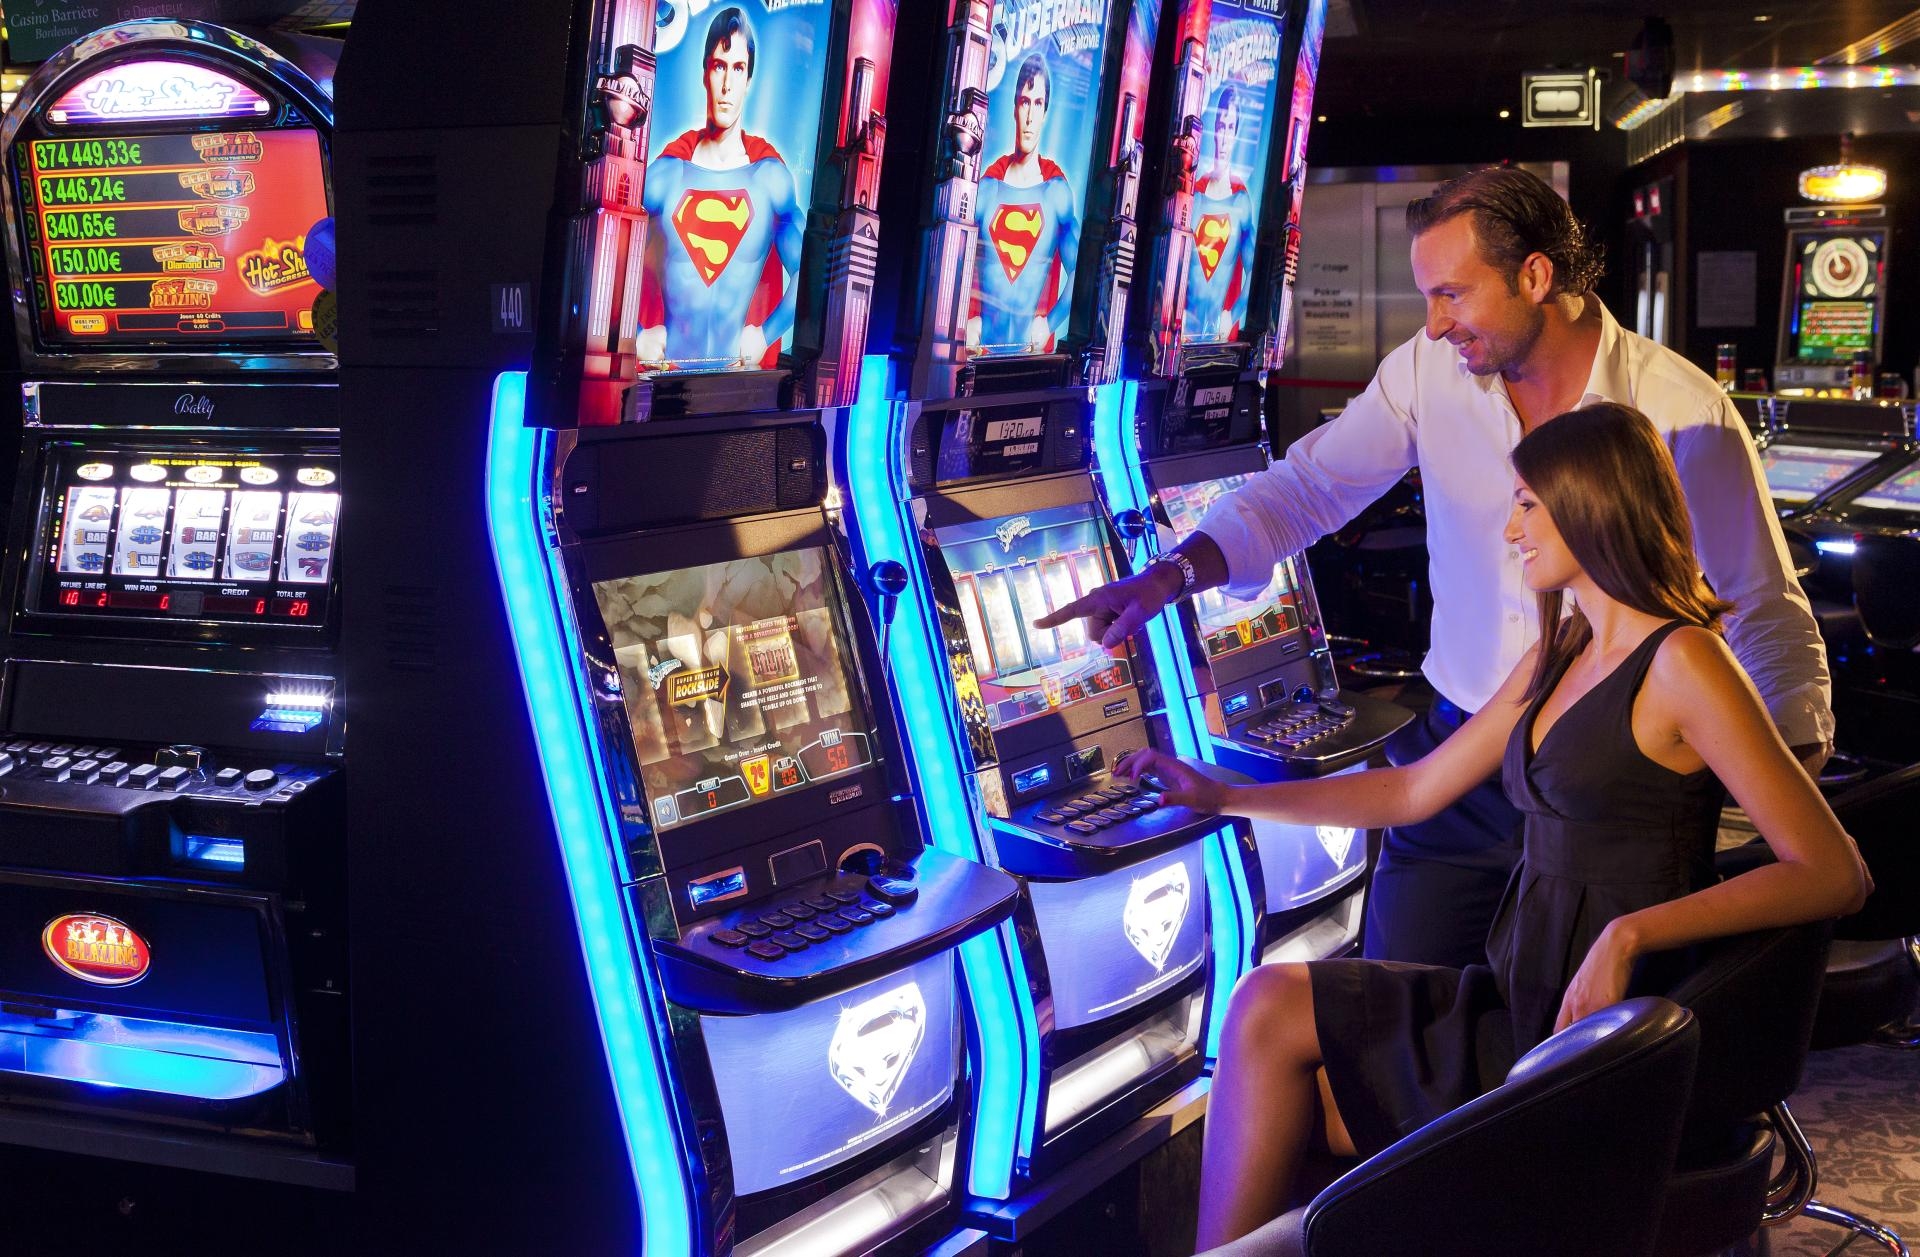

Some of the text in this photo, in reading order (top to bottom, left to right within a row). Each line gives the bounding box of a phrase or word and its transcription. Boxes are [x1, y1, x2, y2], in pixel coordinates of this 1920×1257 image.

[11, 6, 99, 27] Casino Barrière
[35, 26, 78, 40] Bordeaux
[36, 140, 142, 169] 374 449,33€
[203, 142, 260, 157] BLAZING
[42, 177, 126, 204] 3 446,24€
[47, 213, 117, 240] 340,65€
[52, 248, 122, 275] 150,00€
[168, 259, 221, 270] Diamond Line
[246, 257, 280, 289] Hot
[282, 248, 307, 276] Sh
[264, 270, 310, 287] PROGRESSI
[57, 283, 117, 309] 30,00€
[154, 293, 208, 306] BLAZING
[501, 287, 522, 327] 440
[175, 393, 215, 420] Bally
[86, 530, 108, 544] BAR
[195, 528, 218, 543] BAR
[251, 529, 274, 544] BAR
[65, 591, 79, 605] 10
[98, 592, 107, 607] 2
[221, 588, 249, 597] CREDIT
[276, 590, 306, 599] TOTAL BET
[160, 595, 169, 610] 0
[255, 600, 264, 614] 0
[290, 602, 309, 616] 20
[676, 669, 720, 685] SUPER STRENGTH
[676, 677, 720, 698] ROCKSLIDE
[762, 684, 784, 695] POWERFUL
[807, 675, 818, 684] THAT
[766, 693, 779, 702] REELS
[779, 691, 789, 699] AND
[822, 731, 839, 746] WIN
[724, 752, 738, 762] Game
[738, 750, 750, 759] Over
[753, 744, 767, 755] Insert
[767, 741, 781, 751] Credit
[826, 745, 848, 772] 50
[701, 780, 717, 791] CREDIT
[707, 792, 716, 808] 0
[67, 938, 139, 969] BLAZING
